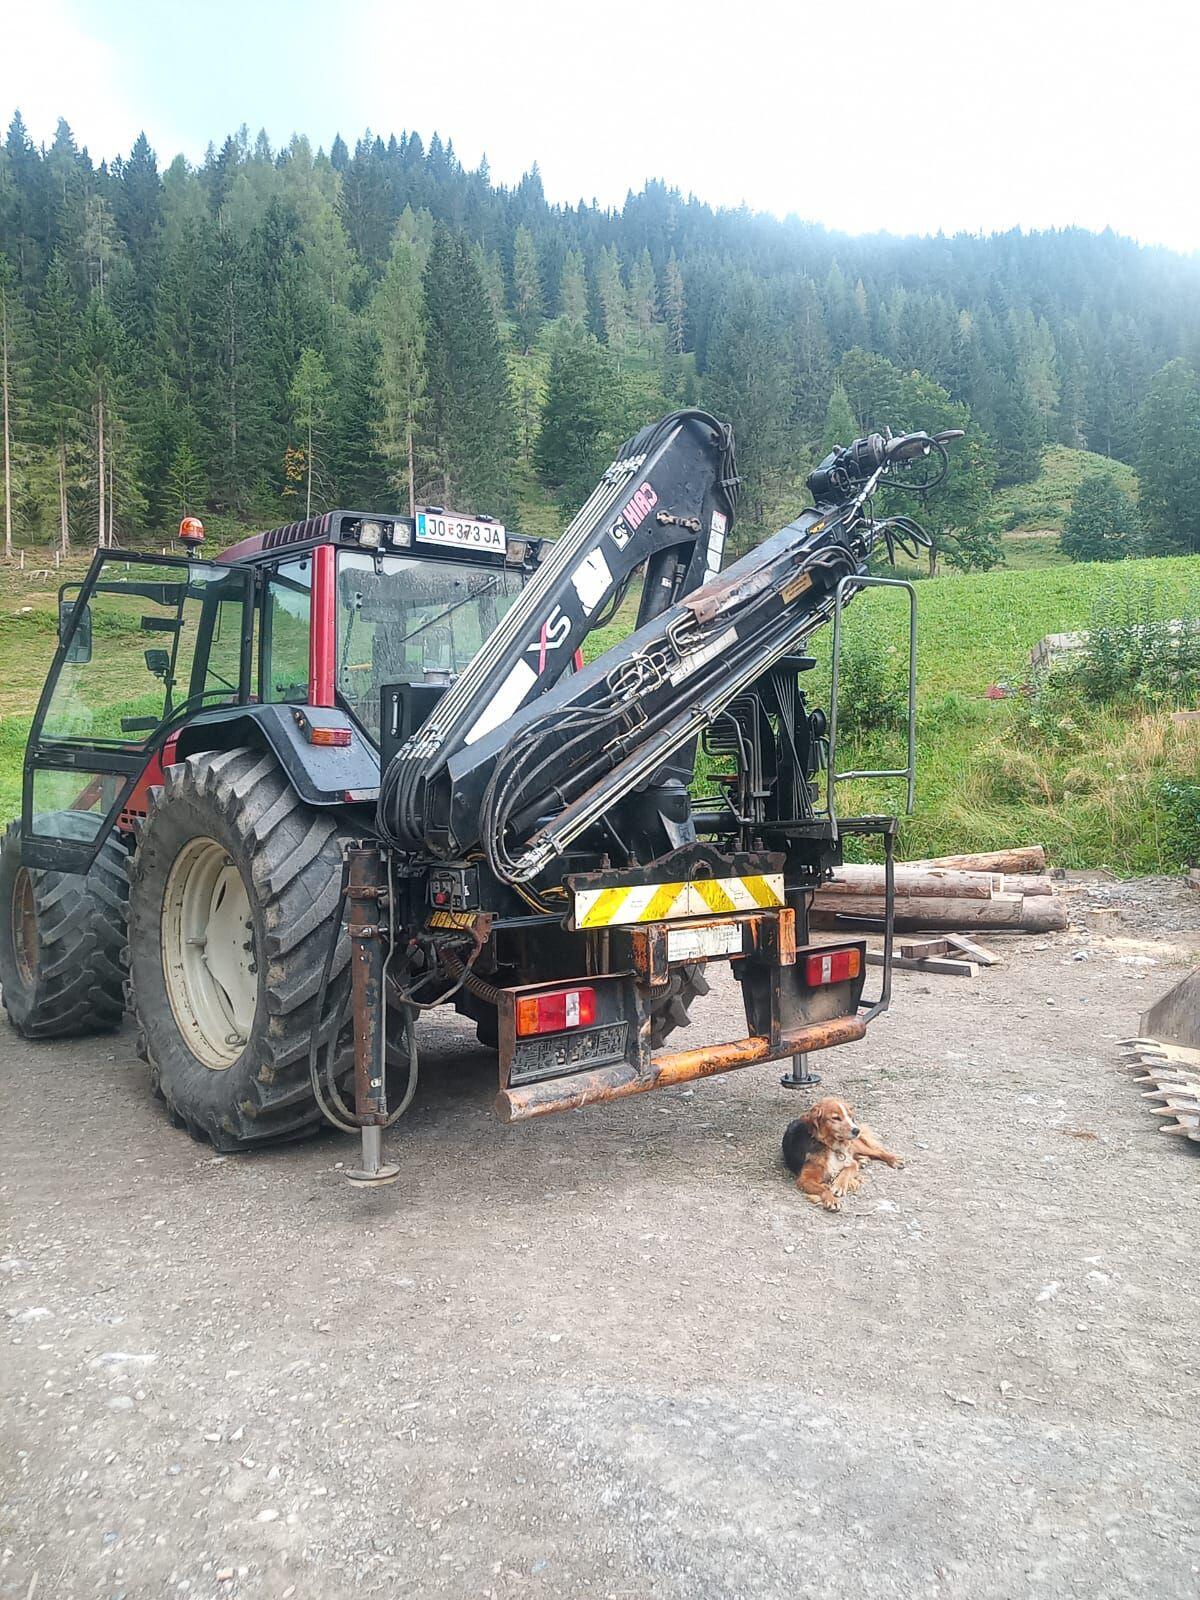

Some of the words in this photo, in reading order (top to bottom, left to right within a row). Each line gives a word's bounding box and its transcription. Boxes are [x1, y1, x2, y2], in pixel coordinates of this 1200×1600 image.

[429, 519, 446, 536] JO
[456, 523, 480, 540] 373
[484, 527, 501, 545] JA
[526, 604, 572, 676] XS
